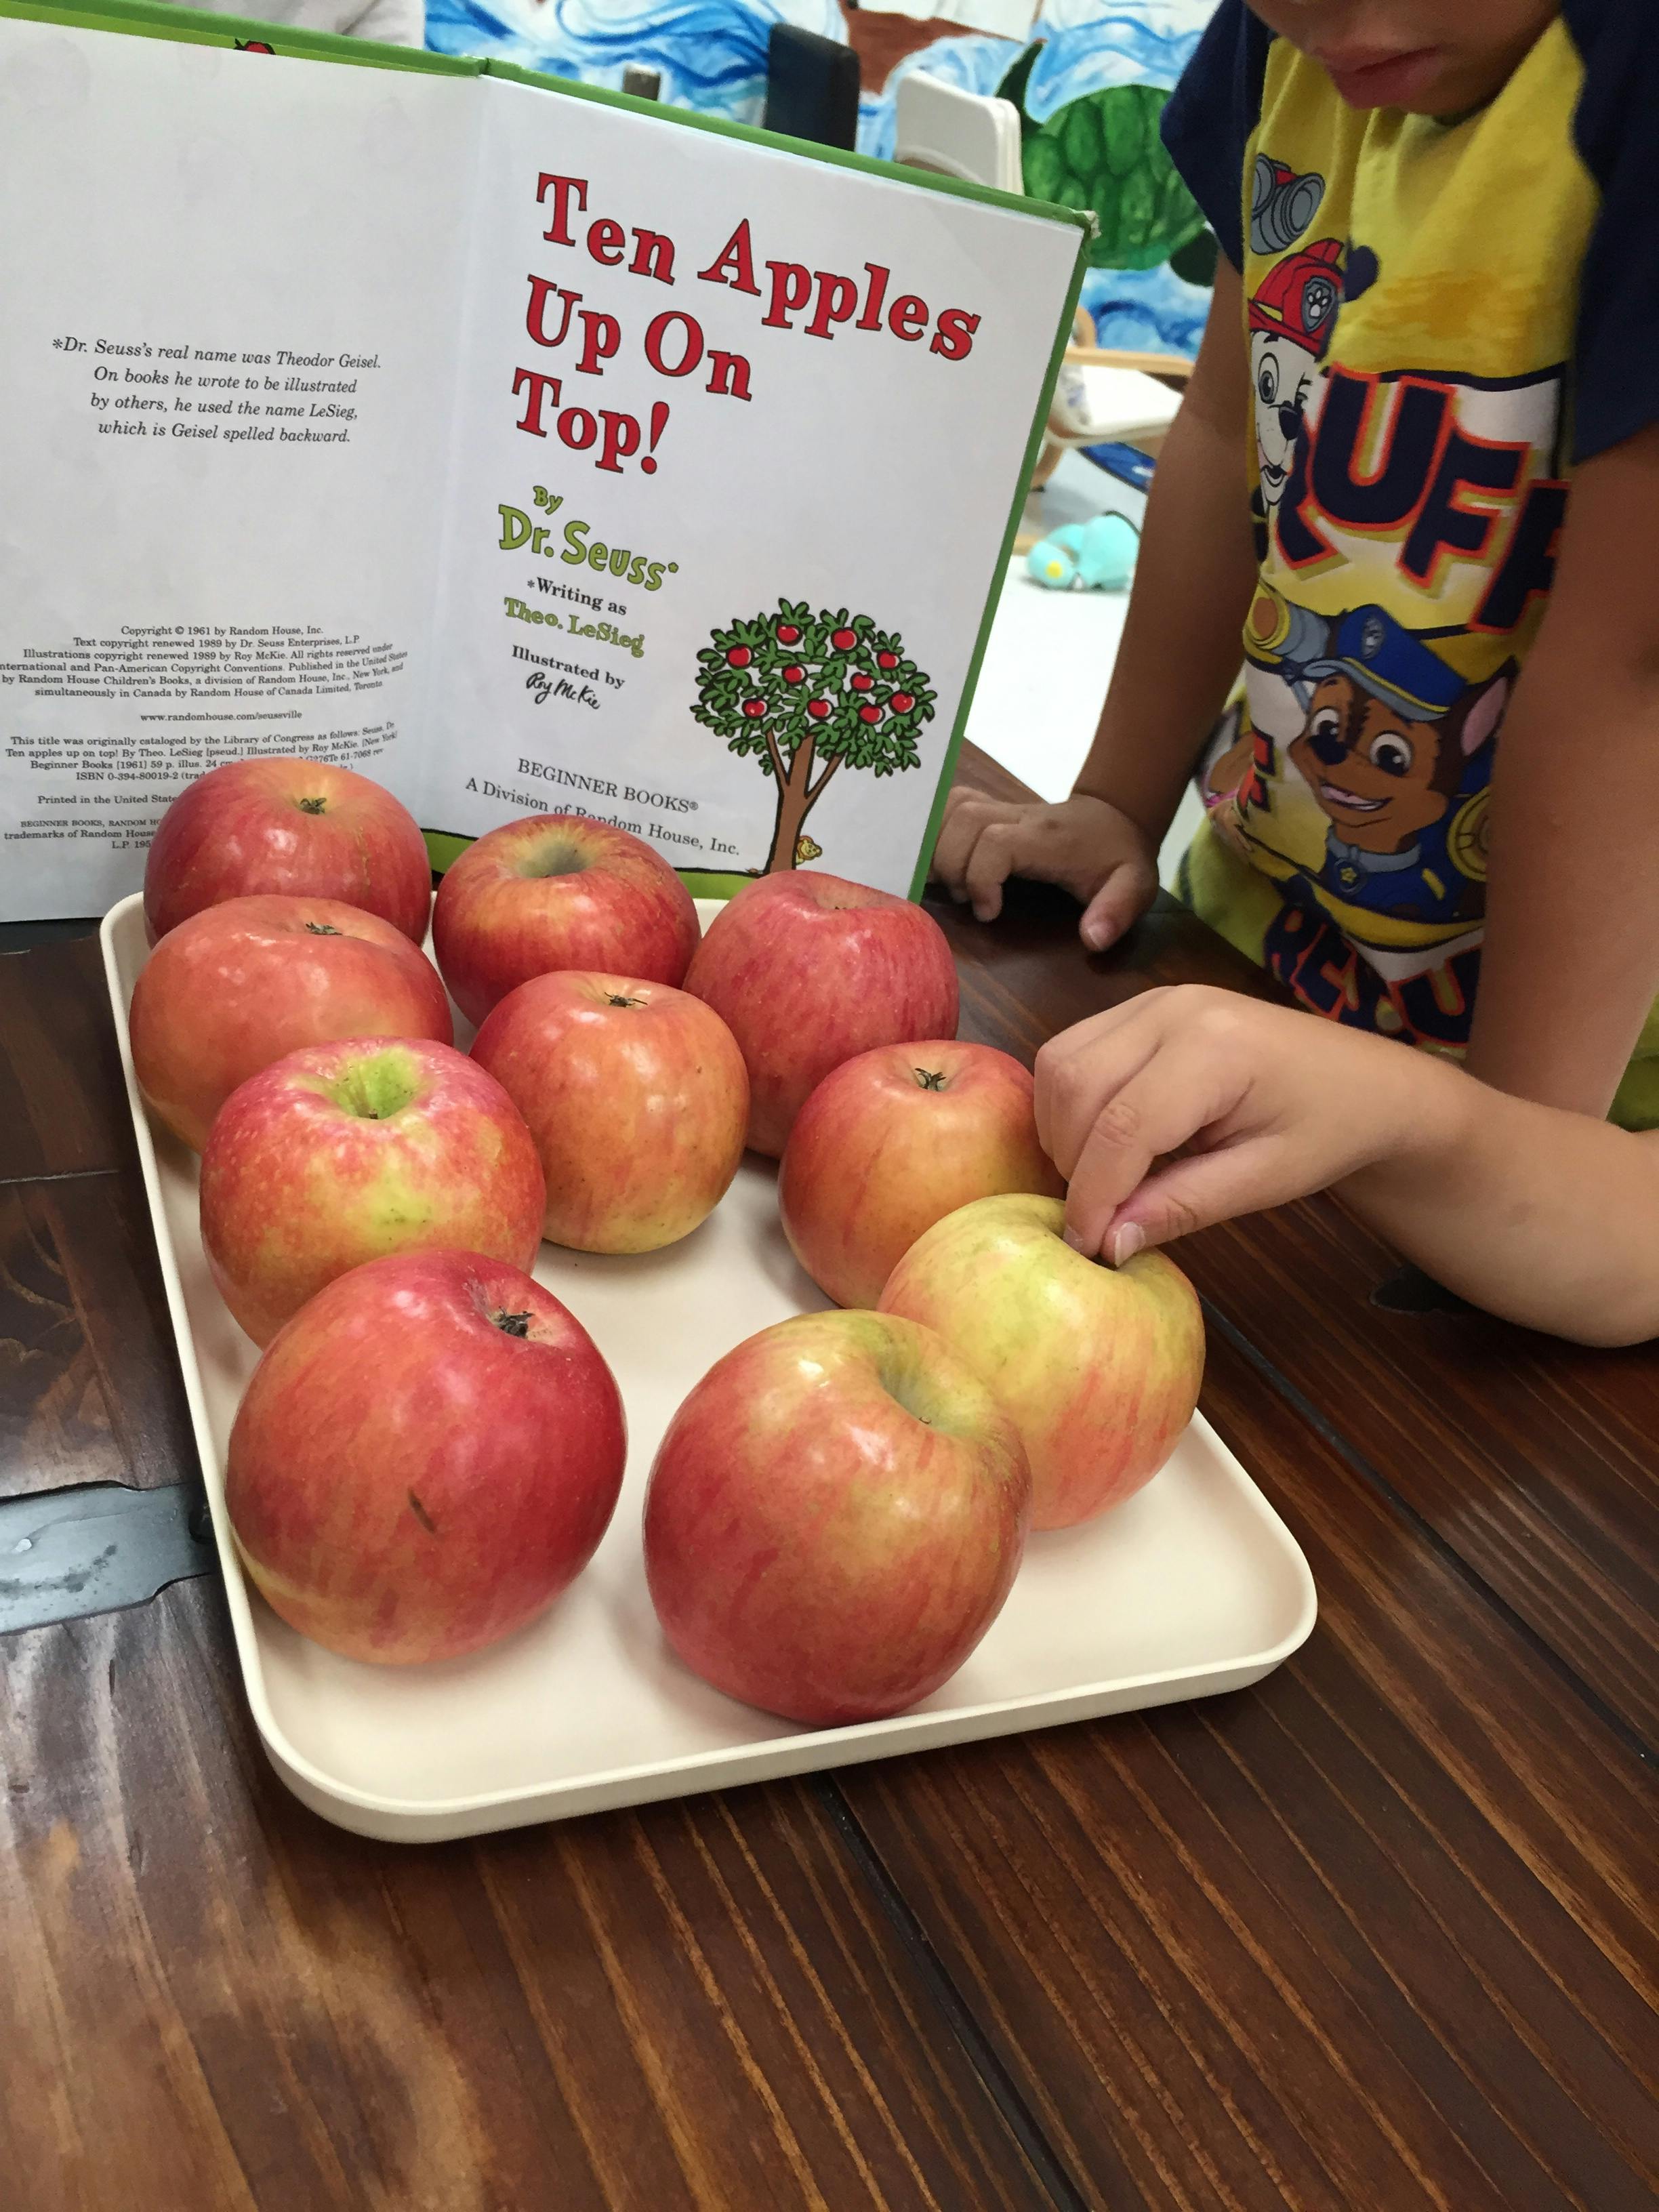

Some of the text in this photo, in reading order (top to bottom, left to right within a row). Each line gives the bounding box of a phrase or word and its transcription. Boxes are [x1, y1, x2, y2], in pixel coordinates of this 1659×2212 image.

[536, 172, 981, 362] Ten Apples
[526, 273, 753, 402] Up On
[158, 345, 189, 359] real
[194, 350, 237, 363] name
[242, 353, 271, 364] was
[276, 351, 335, 367] Theodor
[339, 354, 381, 368] Geisel.
[94, 366, 357, 393] On books he wrote to be illustrated
[91, 392, 357, 421] by others, he used the name LeSieg,
[511, 367, 670, 475] Top!
[98, 420, 350, 443] which is Geisel spelled backward.
[533, 485, 564, 516] By
[498, 504, 554, 558] Dr.
[608, 602, 627, 615] as
[121, 626, 172, 637] Copyright
[188, 626, 210, 635] 1961
[214, 626, 226, 637] by
[229, 626, 269, 636] Random
[272, 626, 304, 636] House,
[307, 626, 323, 634] Inc.
[504, 596, 645, 658] Theo. LeSieg
[73, 637, 97, 647] Text
[100, 639, 149, 650] copyright
[152, 638, 194, 648] renewed
[199, 639, 222, 648] 1989
[225, 639, 237, 649] by
[258, 639, 285, 647] Seuss
[288, 638, 342, 648] Enterprises,
[23, 649, 91, 659] Illustrations
[94, 651, 144, 662] copyright
[146, 651, 189, 660] renewed
[193, 651, 216, 660] 1989
[219, 651, 231, 661] by
[234, 651, 252, 662] Roy
[255, 651, 287, 660] McKie.
[290, 650, 304, 659] All
[307, 649, 333, 660] rights
[335, 645, 370, 657] reserved
[0, 662, 66, 671] nternational
[70, 663, 91, 672] and
[94, 663, 167, 672] Pan-American
[171, 663, 220, 674] Copyright
[289, 661, 333, 671] Published
[335, 661, 344, 669] in
[346, 659, 360, 668] the
[362, 655, 387, 666] United
[512, 645, 625, 689] Illustrated by
[1, 674, 16, 685] by
[18, 674, 63, 684] Random
[66, 675, 100, 684] House
[104, 676, 156, 685] Children's
[159, 676, 192, 685] Books,
[204, 676, 243, 684] division
[246, 676, 256, 684] of
[258, 675, 295, 684] Random
[299, 674, 329, 683] House,
[352, 670, 370, 680] New
[35, 683, 351, 699] simultaneously in Canada by Random House of Canada Limited,
[526, 672, 600, 710] Roy McKie
[140, 712, 302, 721] www.randomhouse.com/seussville
[10, 736, 35, 745] This
[38, 737, 60, 745] title
[87, 737, 137, 747] originally
[140, 736, 186, 747] cataloged
[190, 736, 202, 746] by
[205, 736, 220, 744] the
[224, 735, 260, 745] Library
[262, 735, 272, 743] of
[273, 734, 314, 744] Congress
[5, 748, 25, 757] Ten
[28, 748, 63, 759] apples
[98, 749, 118, 759] top!
[122, 749, 136, 759] By
[138, 748, 166, 757] Theo.
[169, 747, 203, 758] LeSieg
[247, 745, 295, 755] Illustrated
[299, 745, 310, 754] by
[312, 743, 329, 753] Roy
[30, 760, 79, 771] Beginner
[81, 760, 113, 769] Books
[150, 760, 163, 769] 59
[178, 760, 202, 768] illus.
[76, 772, 104, 780] ISBN
[518, 758, 617, 797] BEGINNER
[37, 795, 148, 804] Printed in the United
[71, 819, 105, 827] BOOKS,
[466, 777, 739, 855] A Division of House, Inc.
[4, 830, 122, 840] trademarks of Random
